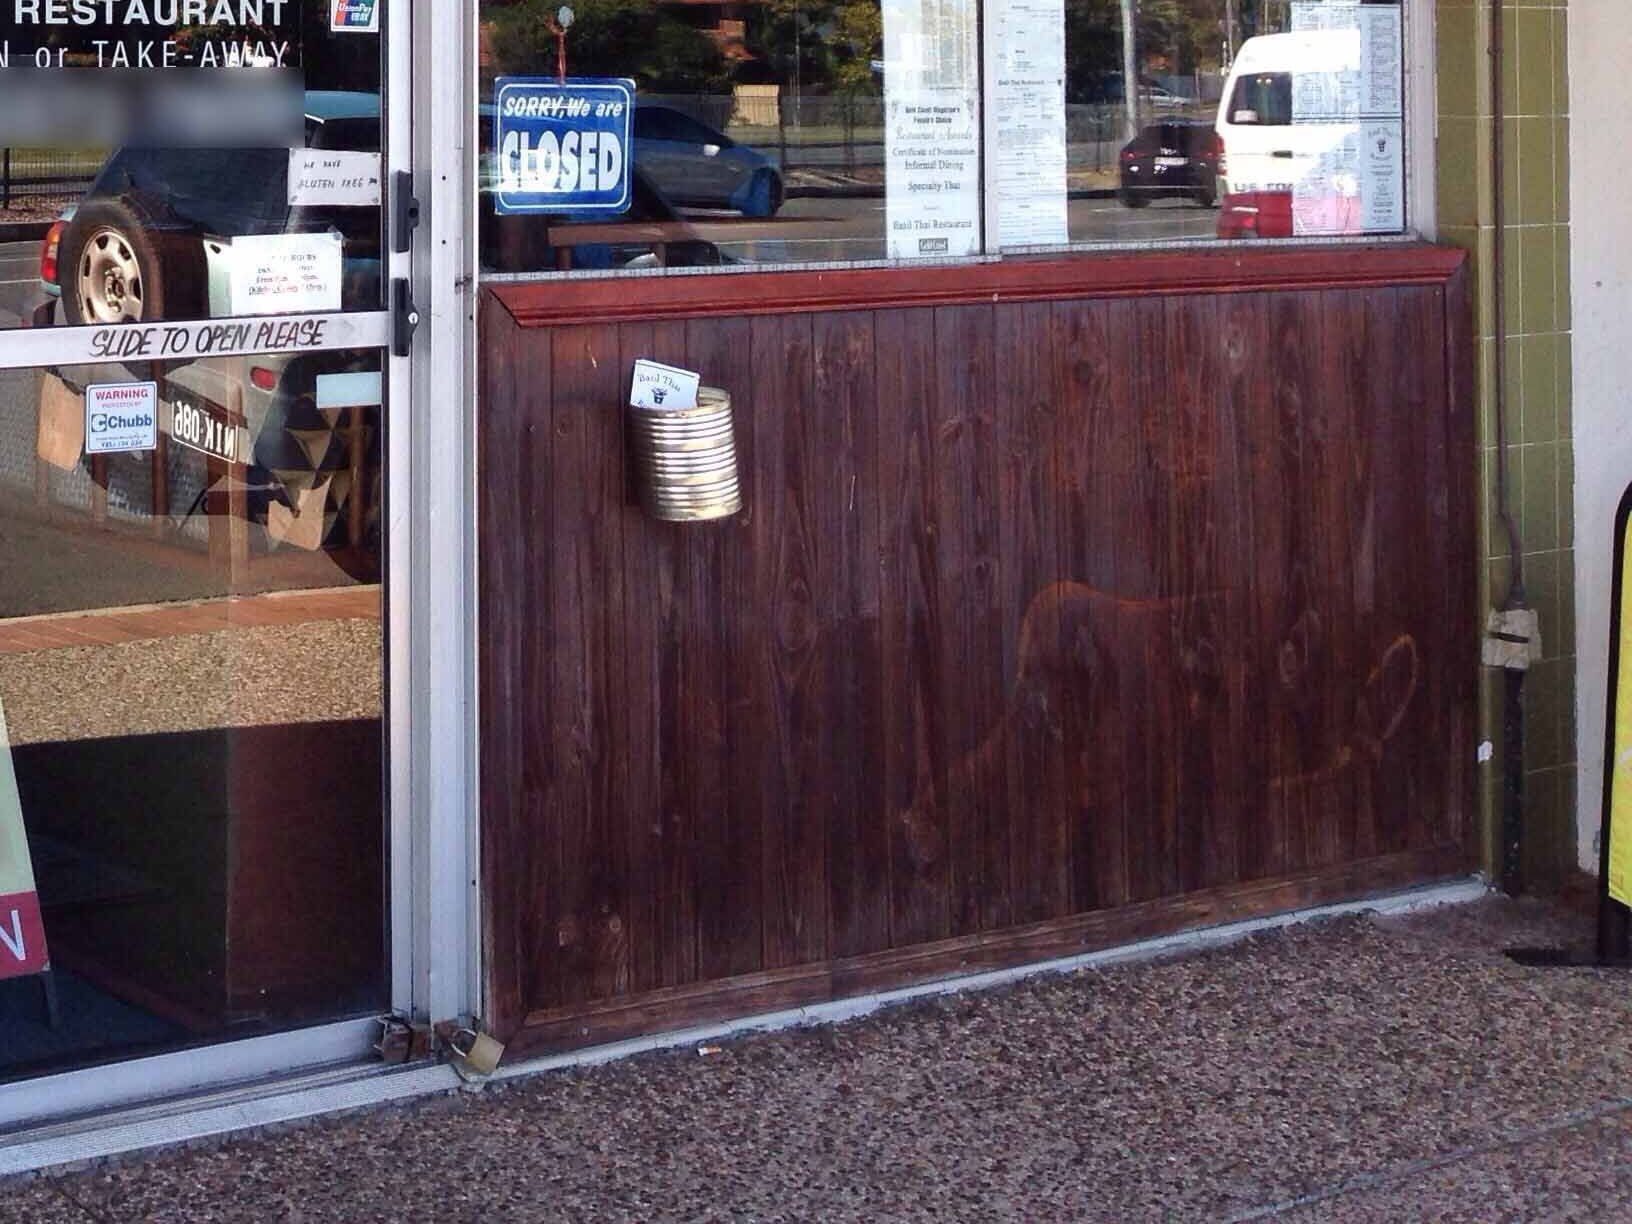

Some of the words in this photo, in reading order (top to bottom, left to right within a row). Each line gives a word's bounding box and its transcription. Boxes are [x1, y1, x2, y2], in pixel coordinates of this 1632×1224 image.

[35, 46, 68, 68] or
[92, 39, 288, 68] TAKE-AWAY
[567, 97, 590, 117] We
[596, 103, 623, 117] are
[502, 130, 622, 192] CLOSED
[89, 327, 157, 357] SLIDE
[159, 327, 190, 355] TO
[195, 323, 251, 353] OPEN
[253, 319, 328, 348] PLEASE
[95, 388, 149, 400] WARNING
[108, 414, 153, 429] Chubb
